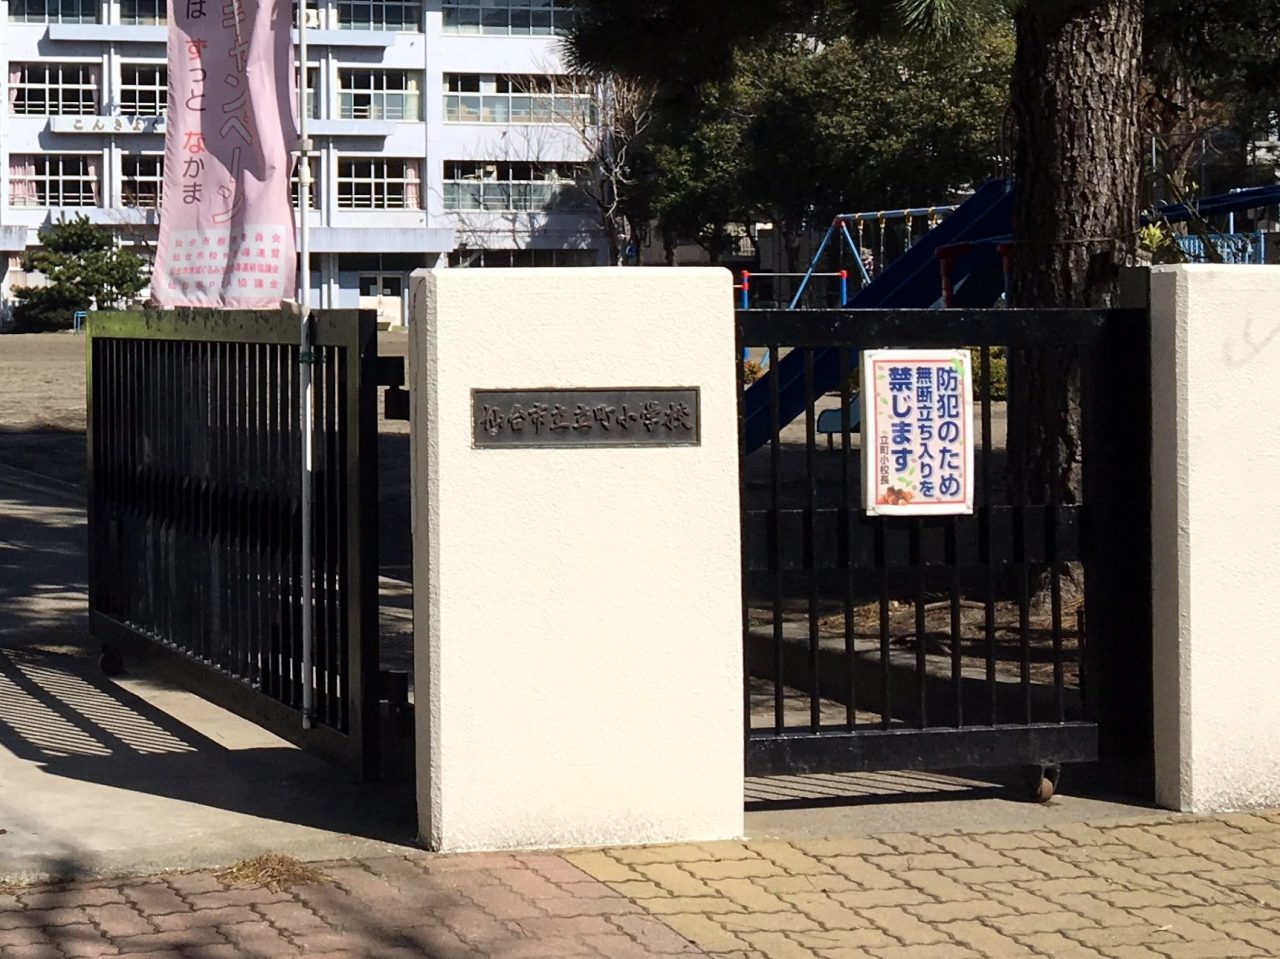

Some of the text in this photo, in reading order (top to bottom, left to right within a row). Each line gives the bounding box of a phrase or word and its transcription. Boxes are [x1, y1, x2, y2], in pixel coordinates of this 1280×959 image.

[479, 401, 693, 435] 仙台市立立町小学校
[888, 366, 914, 473] 禁じます
[915, 367, 935, 498] 無断立ち入りを
[936, 367, 961, 497] 防犯のため
